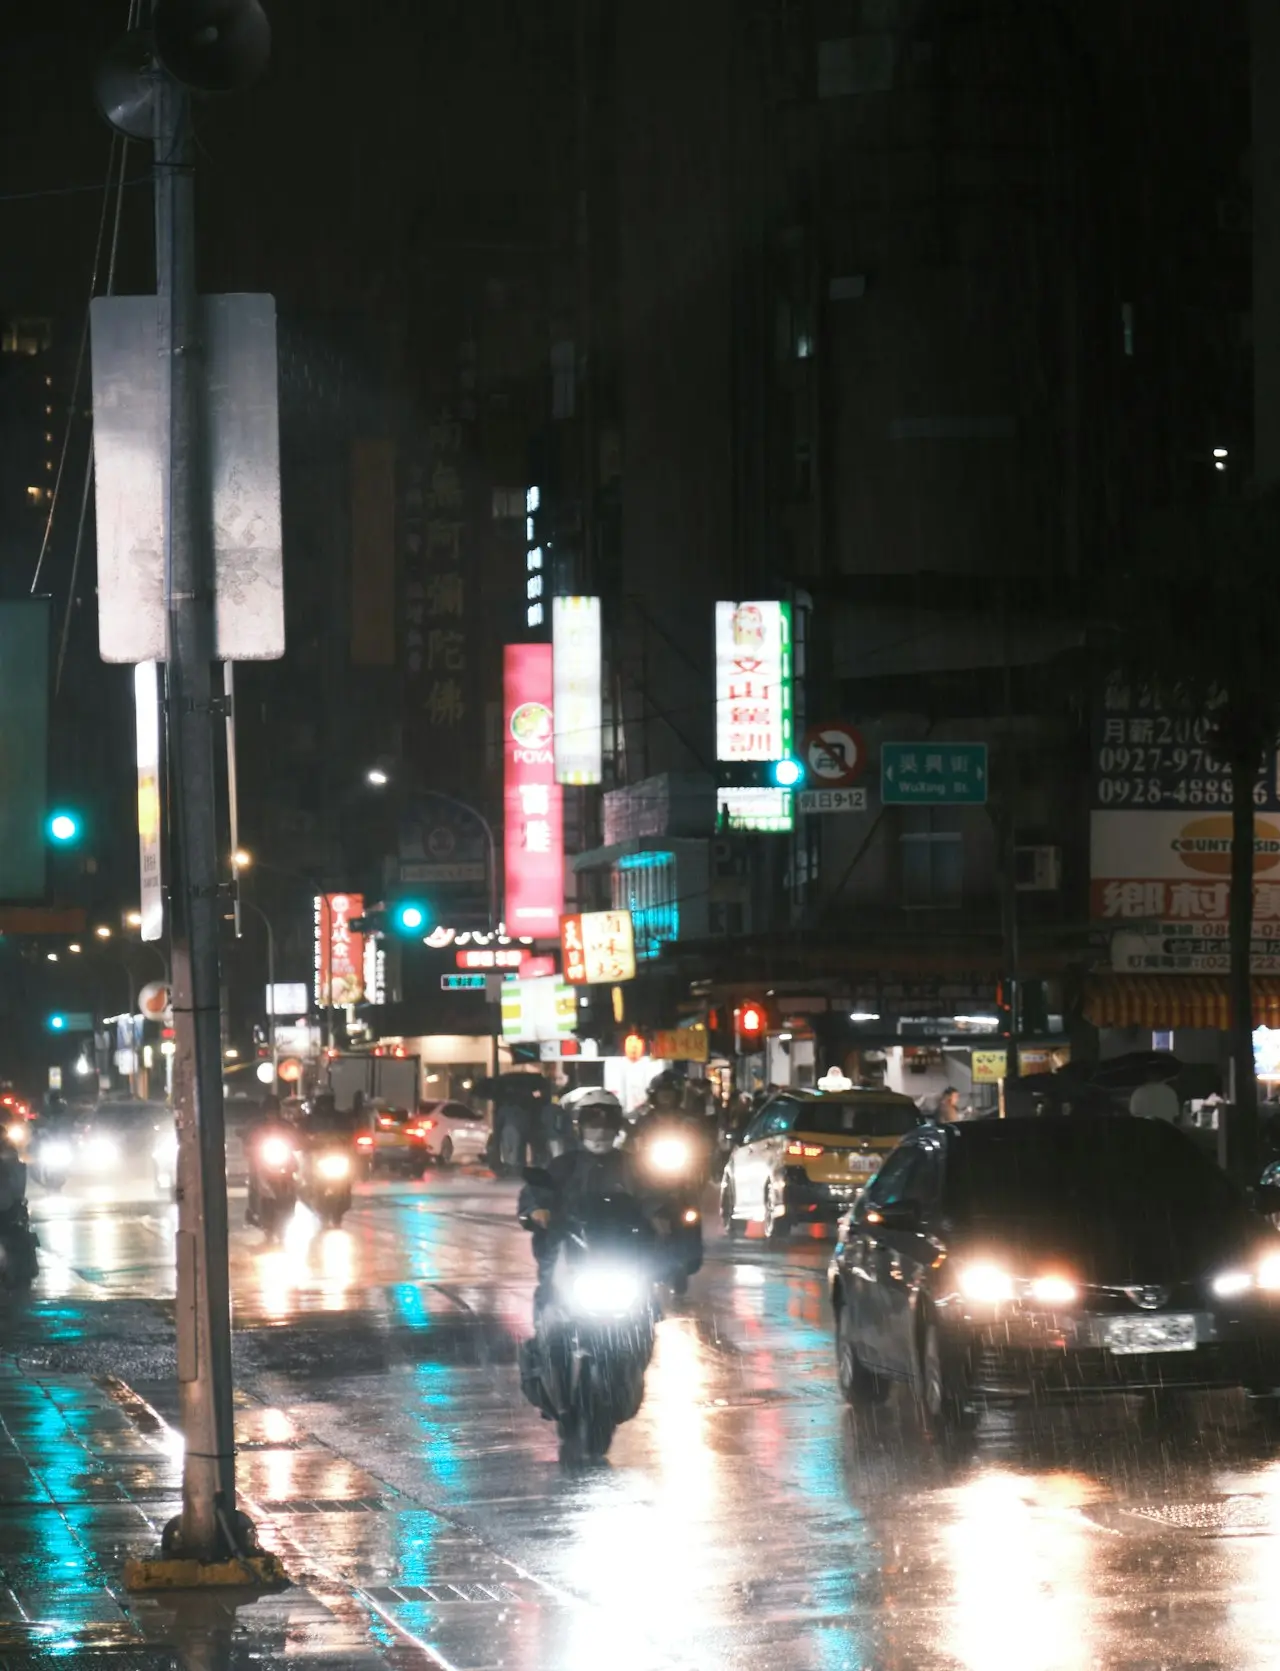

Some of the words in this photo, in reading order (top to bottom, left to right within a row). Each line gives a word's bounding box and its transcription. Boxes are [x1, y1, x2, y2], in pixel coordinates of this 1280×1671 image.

[899, 754, 969, 774] 吳興街
[1098, 779, 1269, 805] 0928-48886
